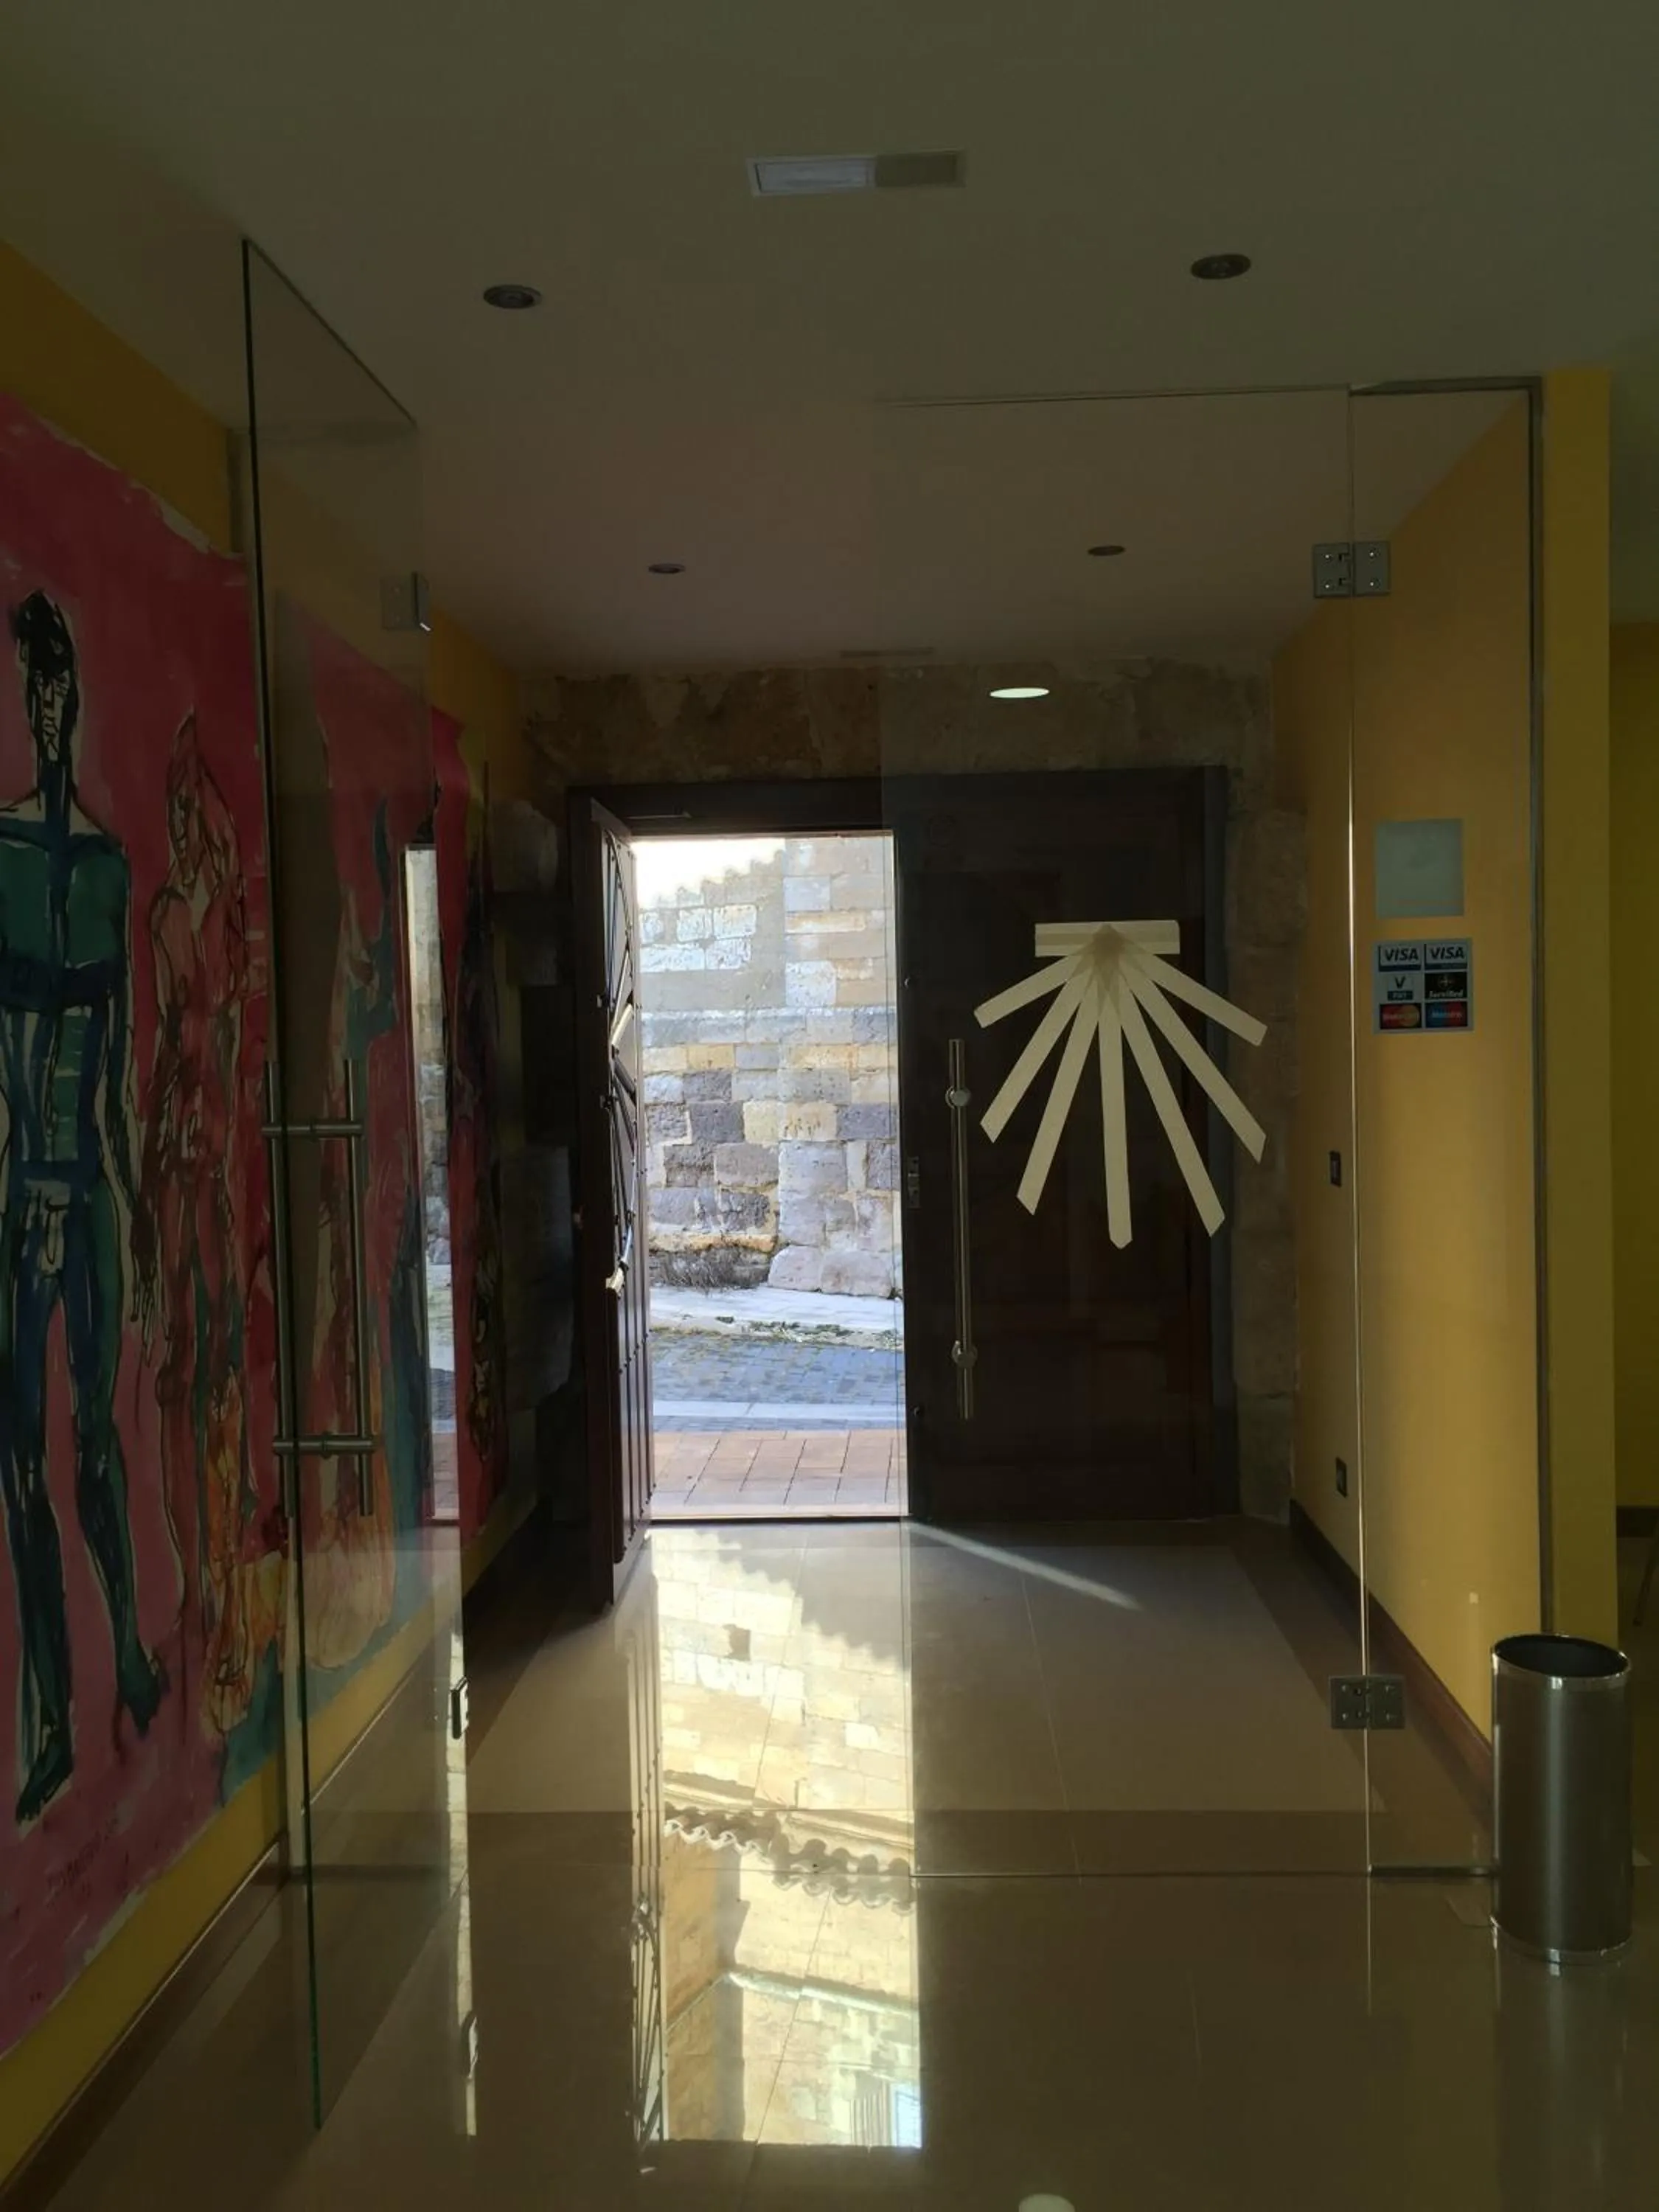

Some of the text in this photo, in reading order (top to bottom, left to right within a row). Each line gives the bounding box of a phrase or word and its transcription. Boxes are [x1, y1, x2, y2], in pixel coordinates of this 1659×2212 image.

[1385, 947, 1419, 961] VISA
[1430, 946, 1464, 960] VISA
[1394, 976, 1406, 989] V
